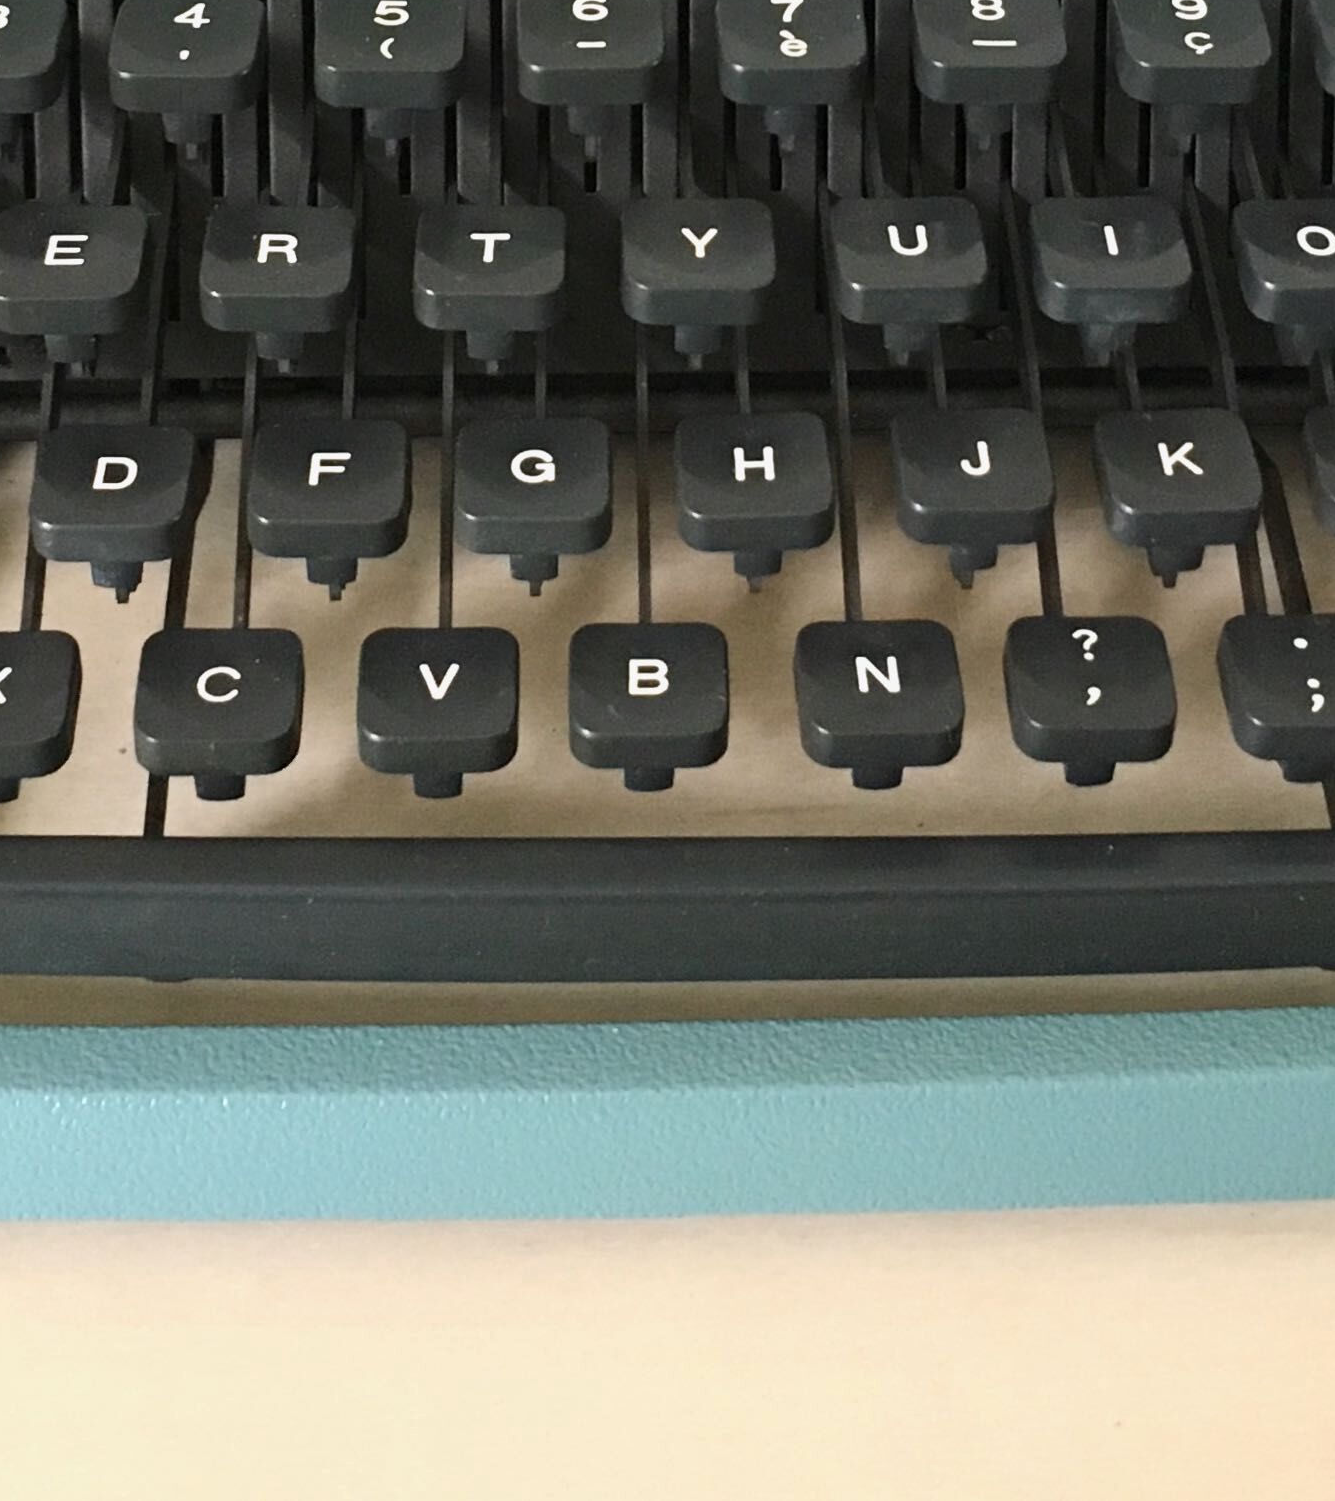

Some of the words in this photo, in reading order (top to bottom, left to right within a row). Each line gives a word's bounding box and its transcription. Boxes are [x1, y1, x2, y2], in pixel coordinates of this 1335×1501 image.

[173, 2, 211, 29] 4
[373, 0, 410, 26] 5
[379, 36, 395, 60] (
[779, 29, 808, 58] è
[1184, 31, 1214, 55] ç
[43, 234, 89, 266] E
[256, 233, 298, 264] R
[469, 232, 511, 263] T
[681, 227, 718, 259] Y
[887, 224, 928, 256] U
[1103, 225, 1119, 256] I
[92, 456, 138, 490] D
[308, 452, 352, 486] F
[510, 449, 556, 484] G
[733, 446, 776, 482] H
[960, 440, 991, 477] J
[1157, 442, 1204, 477] K
[1070, 628, 1099, 662] ?
[196, 666, 242, 703] C
[419, 663, 460, 700] V
[628, 658, 670, 696] B
[855, 655, 901, 694] N
[1306, 678, 1326, 714] ;
